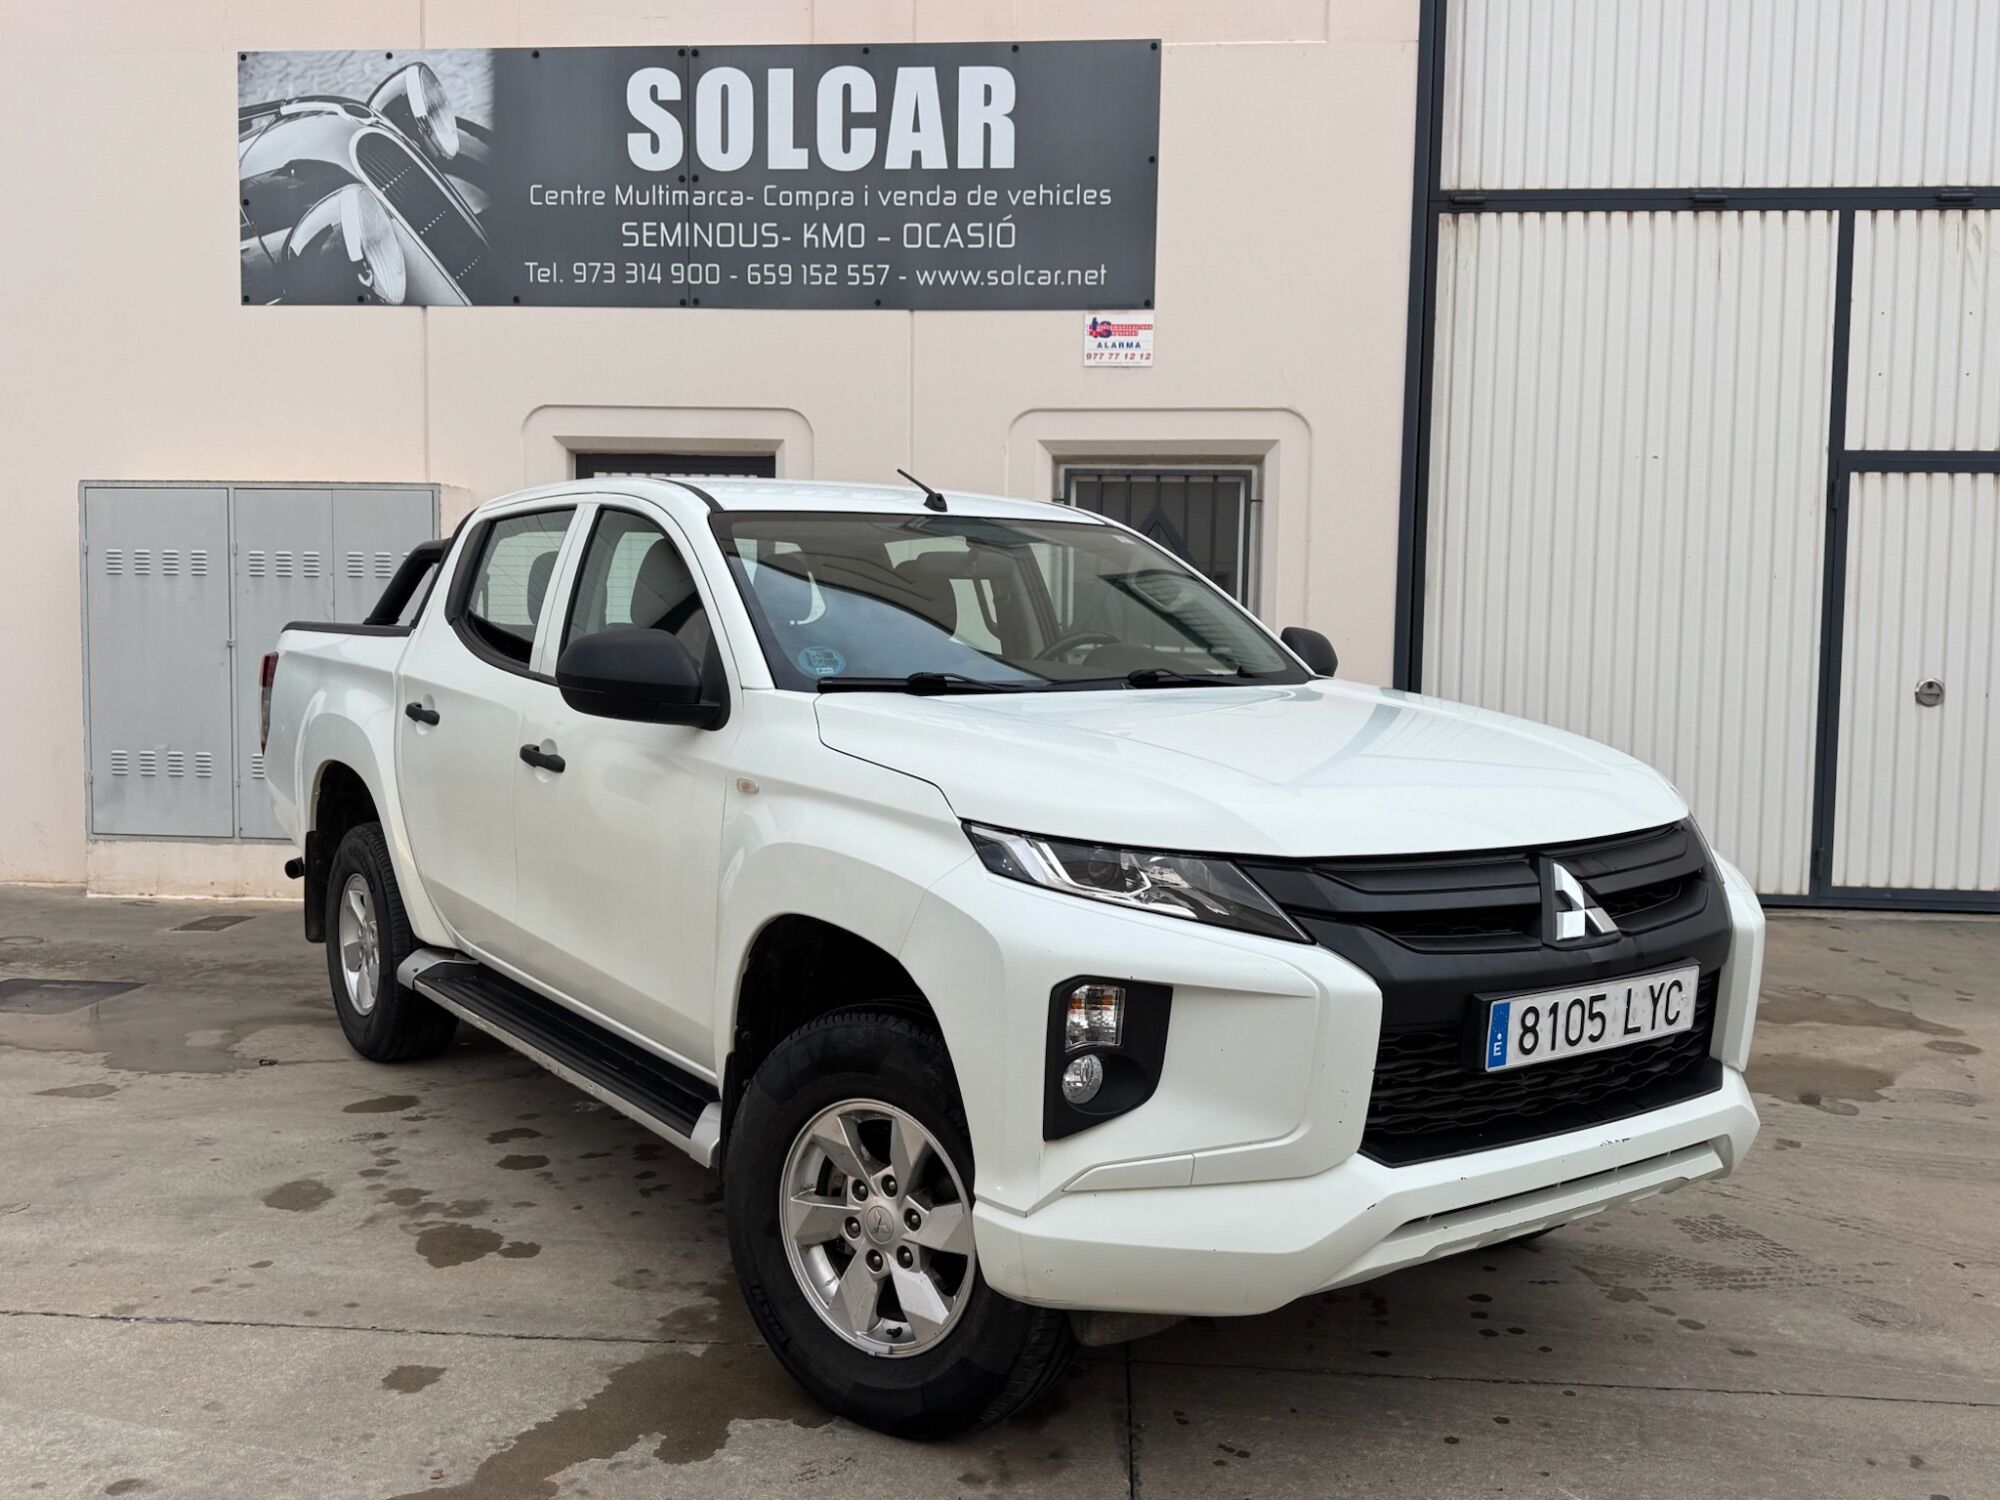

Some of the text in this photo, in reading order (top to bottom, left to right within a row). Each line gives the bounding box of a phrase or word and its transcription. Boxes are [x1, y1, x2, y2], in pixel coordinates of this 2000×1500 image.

[626, 65, 1016, 172] SOLCAR
[529, 183, 1112, 211] Centre Multimarca- Compra i venda de vehicles
[621, 221, 792, 248] SEMINOUS-
[902, 214, 1016, 249] OCASIÓ
[524, 261, 564, 283] Tel.
[572, 262, 616, 284] 973
[625, 262, 662, 284] 314
[670, 262, 720, 285] 900
[747, 263, 792, 285] 659
[801, 263, 838, 286] 152
[847, 264, 890, 286] 557
[915, 263, 1107, 287] www.solcar.net
[1096, 341, 1141, 349] ALARMA
[1108, 352, 1120, 361] 77
[1124, 352, 1136, 361] 12
[1139, 352, 1152, 361] 12
[1518, 979, 1684, 1056] 8105 LYC
[1493, 1041, 1503, 1057] E
